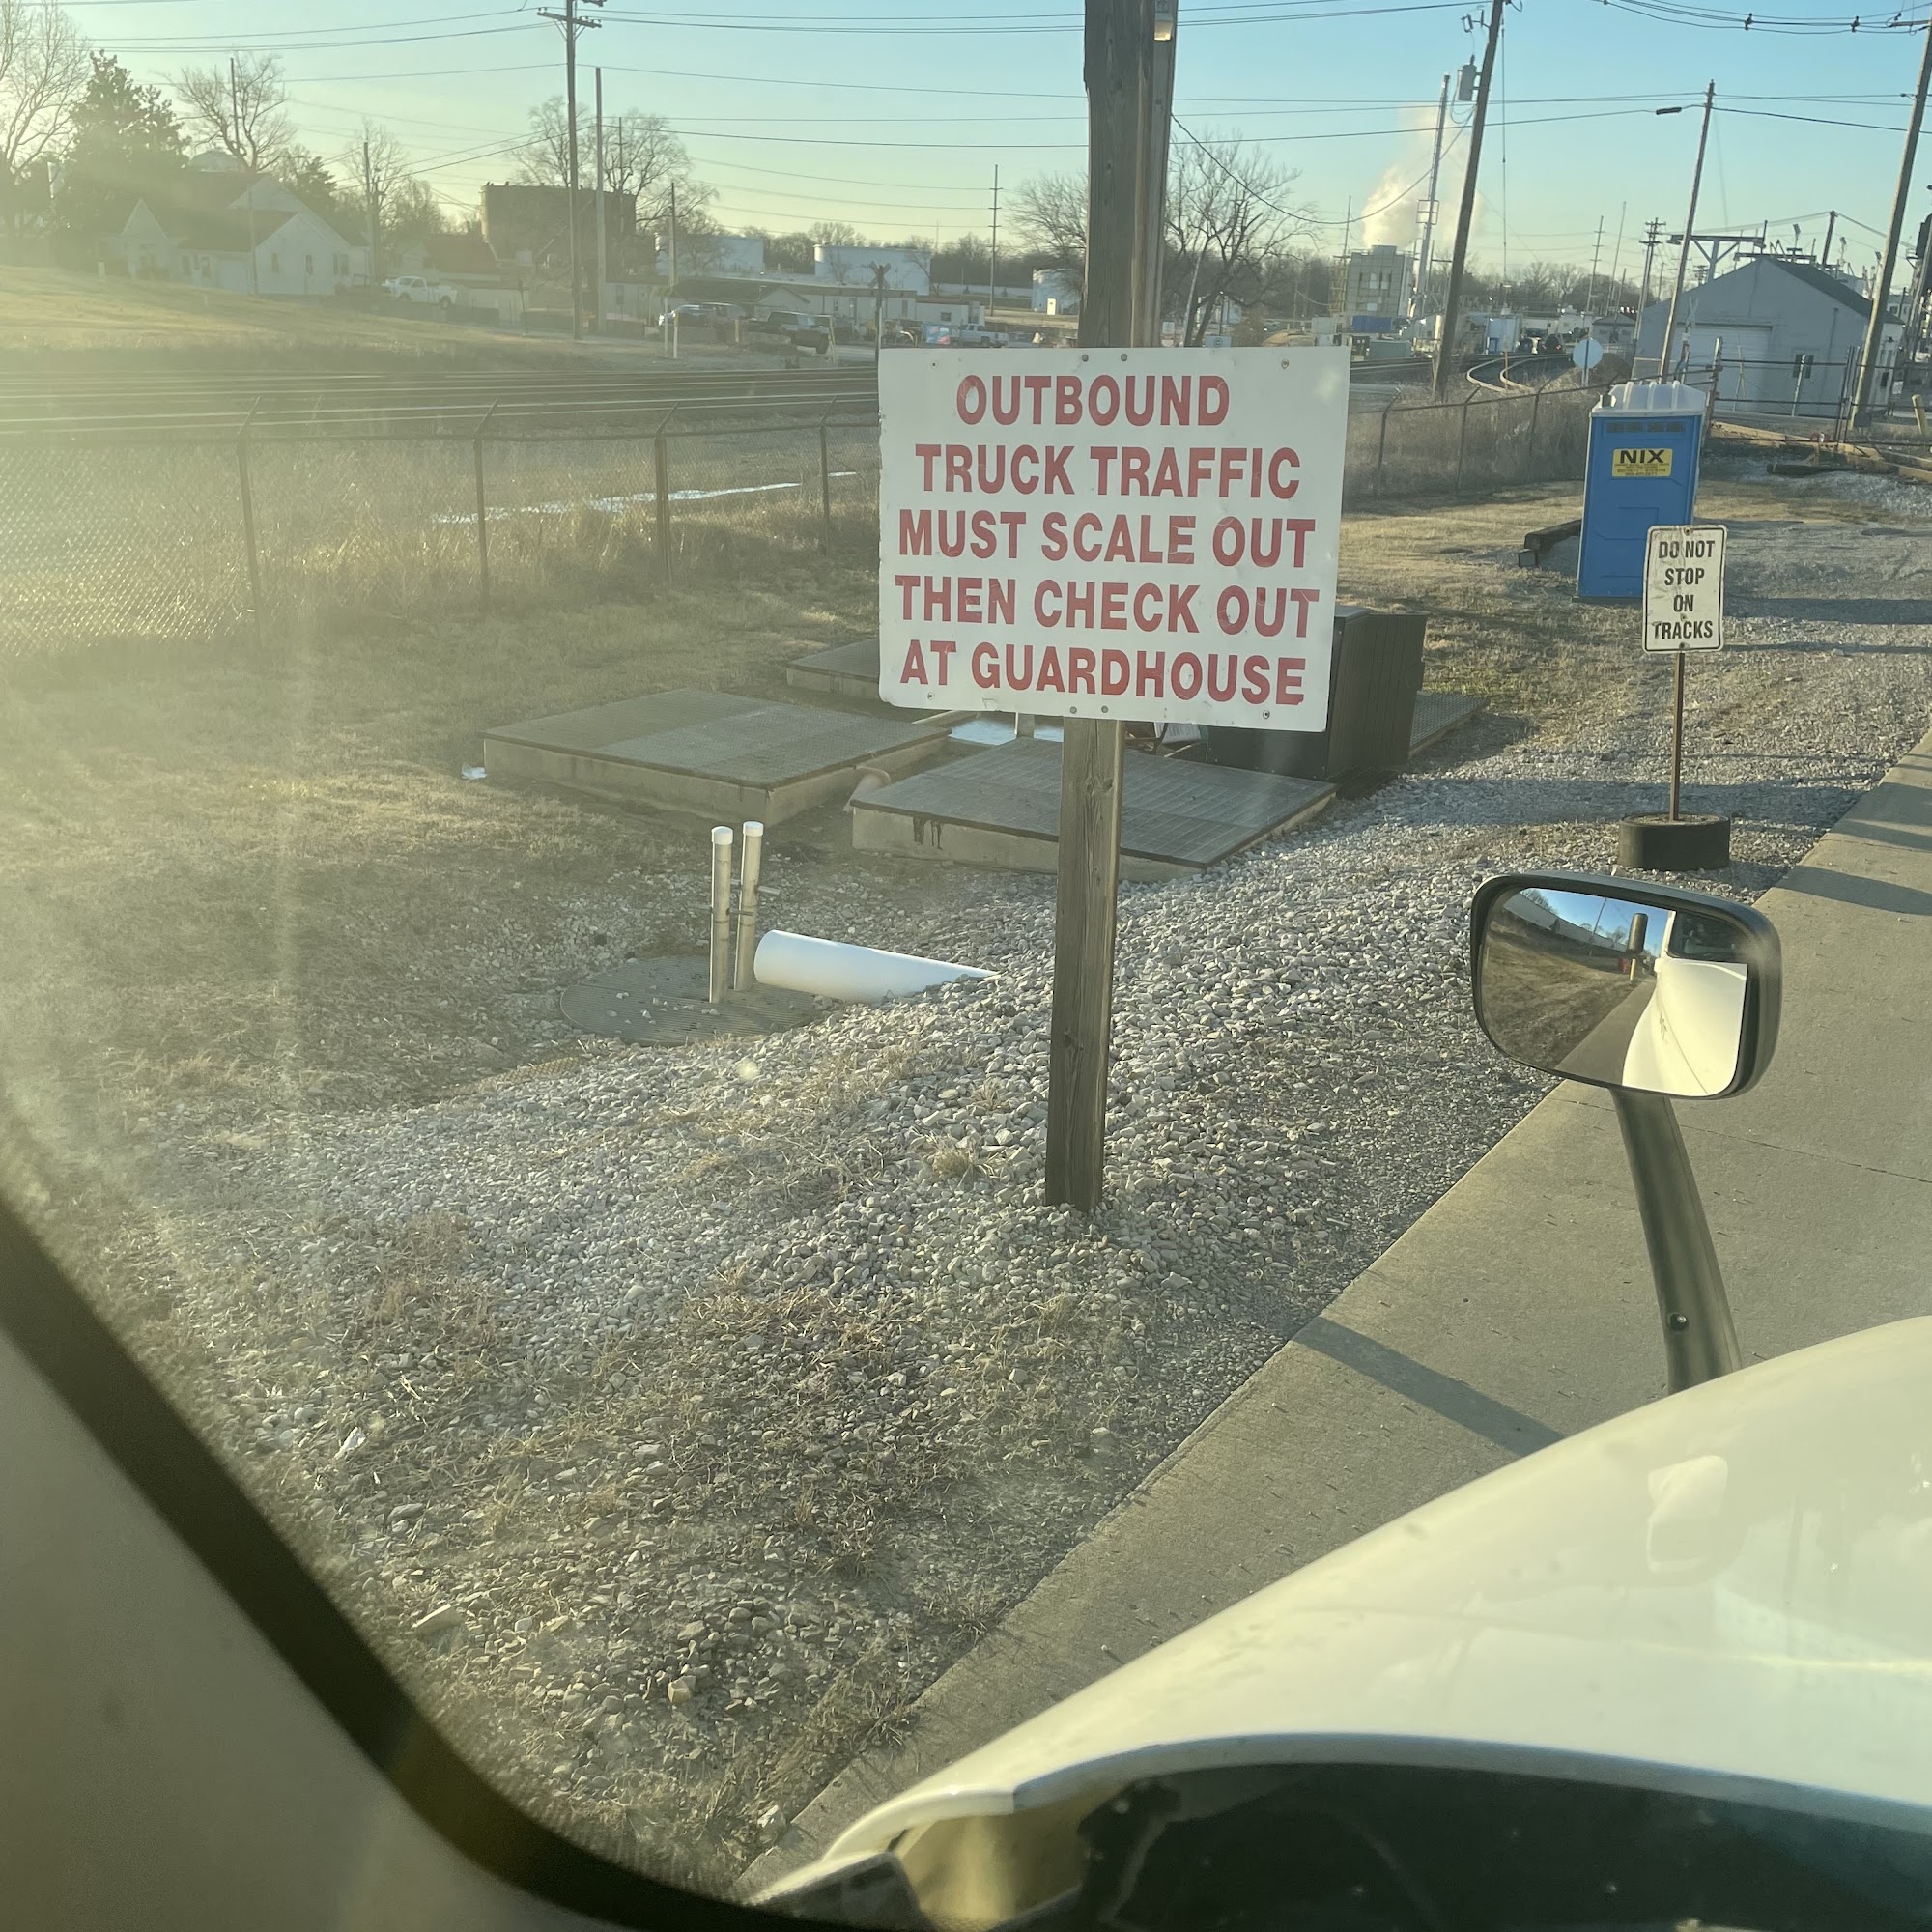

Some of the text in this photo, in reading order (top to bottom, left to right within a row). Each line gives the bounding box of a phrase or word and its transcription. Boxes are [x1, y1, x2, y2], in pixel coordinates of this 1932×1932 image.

[956, 375, 1230, 426] OUTBOUND
[915, 444, 1300, 499] TRUCK TRAFFIC
[1620, 450, 1664, 464] NIX
[899, 509, 1316, 568] MUST SCALE OUT
[1659, 540, 1715, 558] DO NOT
[1664, 567, 1705, 585] STOP
[895, 575, 1320, 638] THEN CHECK OUT
[1673, 594, 1694, 612] ON
[1652, 620, 1713, 639] TRACKS
[899, 639, 1306, 705] AT GUARDHOUSE
